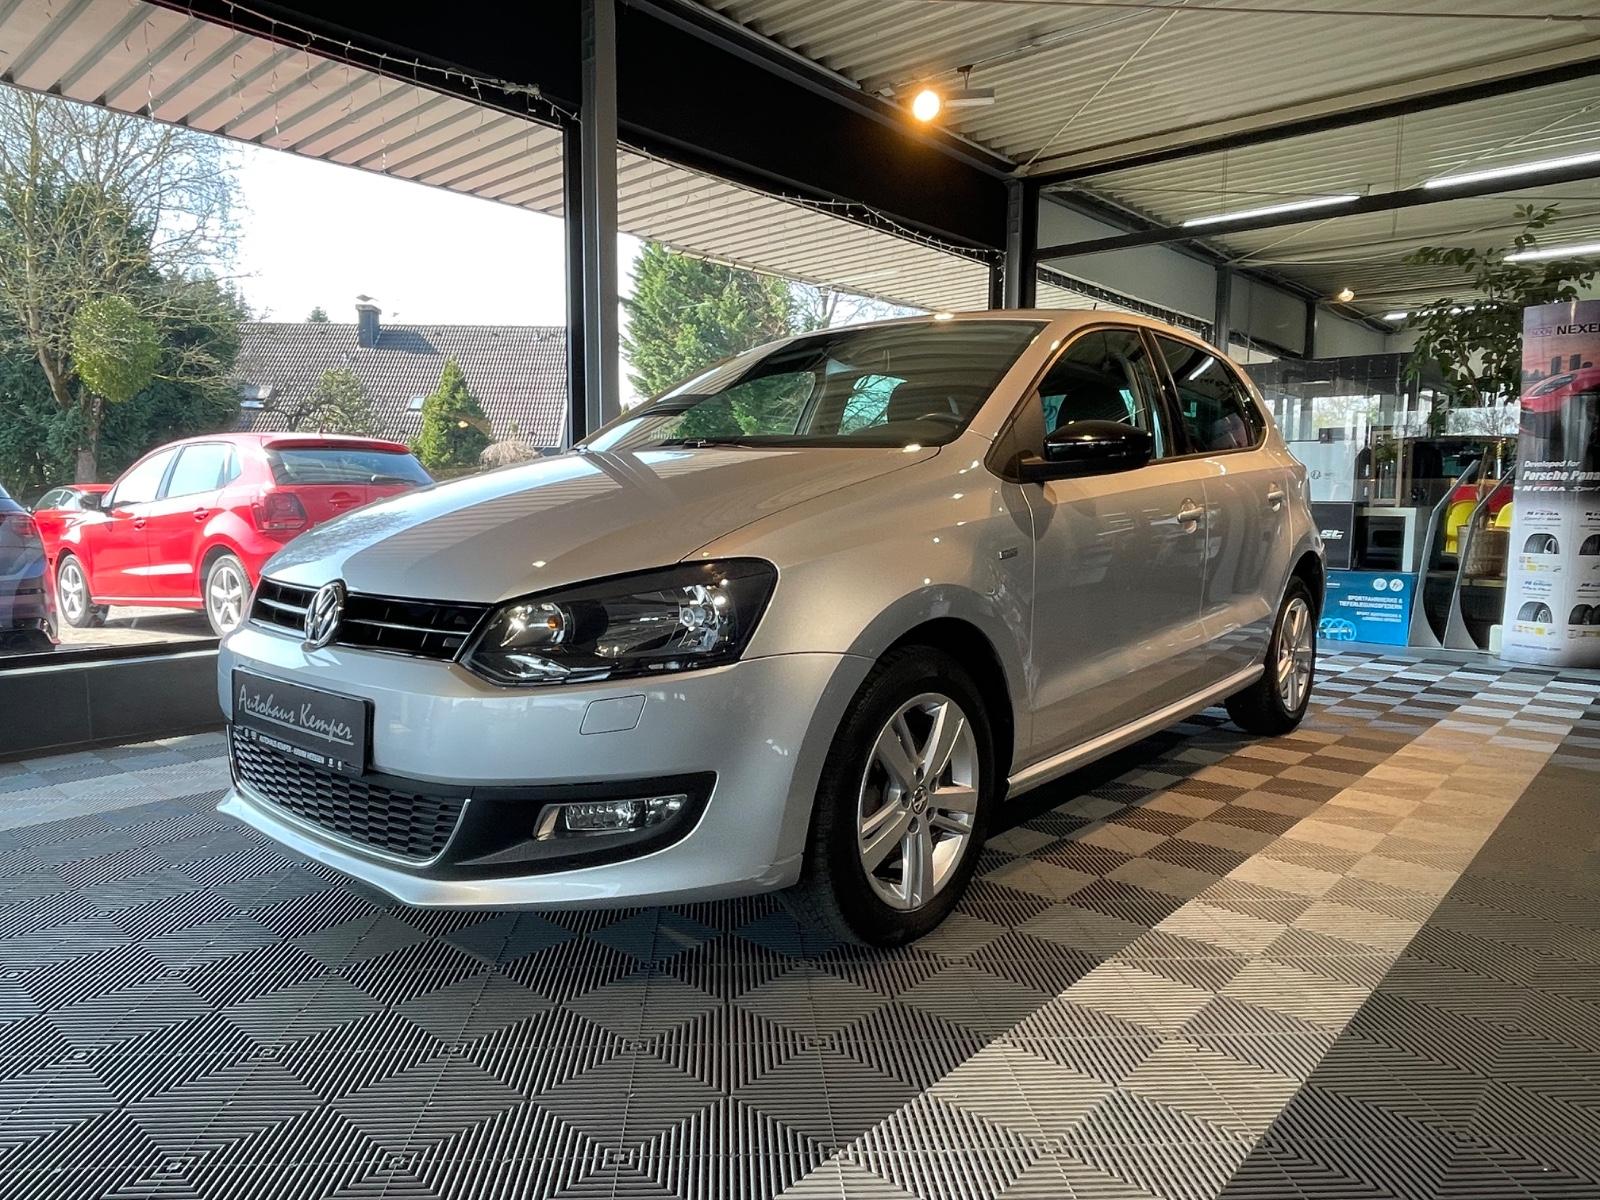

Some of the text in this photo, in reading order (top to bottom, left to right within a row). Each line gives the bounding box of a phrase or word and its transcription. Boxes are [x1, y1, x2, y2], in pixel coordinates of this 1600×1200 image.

[1556, 323, 1600, 335] NEXE
[1524, 460, 1566, 468] Developed
[1523, 470, 1569, 480] Porsche
[239, 684, 353, 743] Autohaus Kemper
